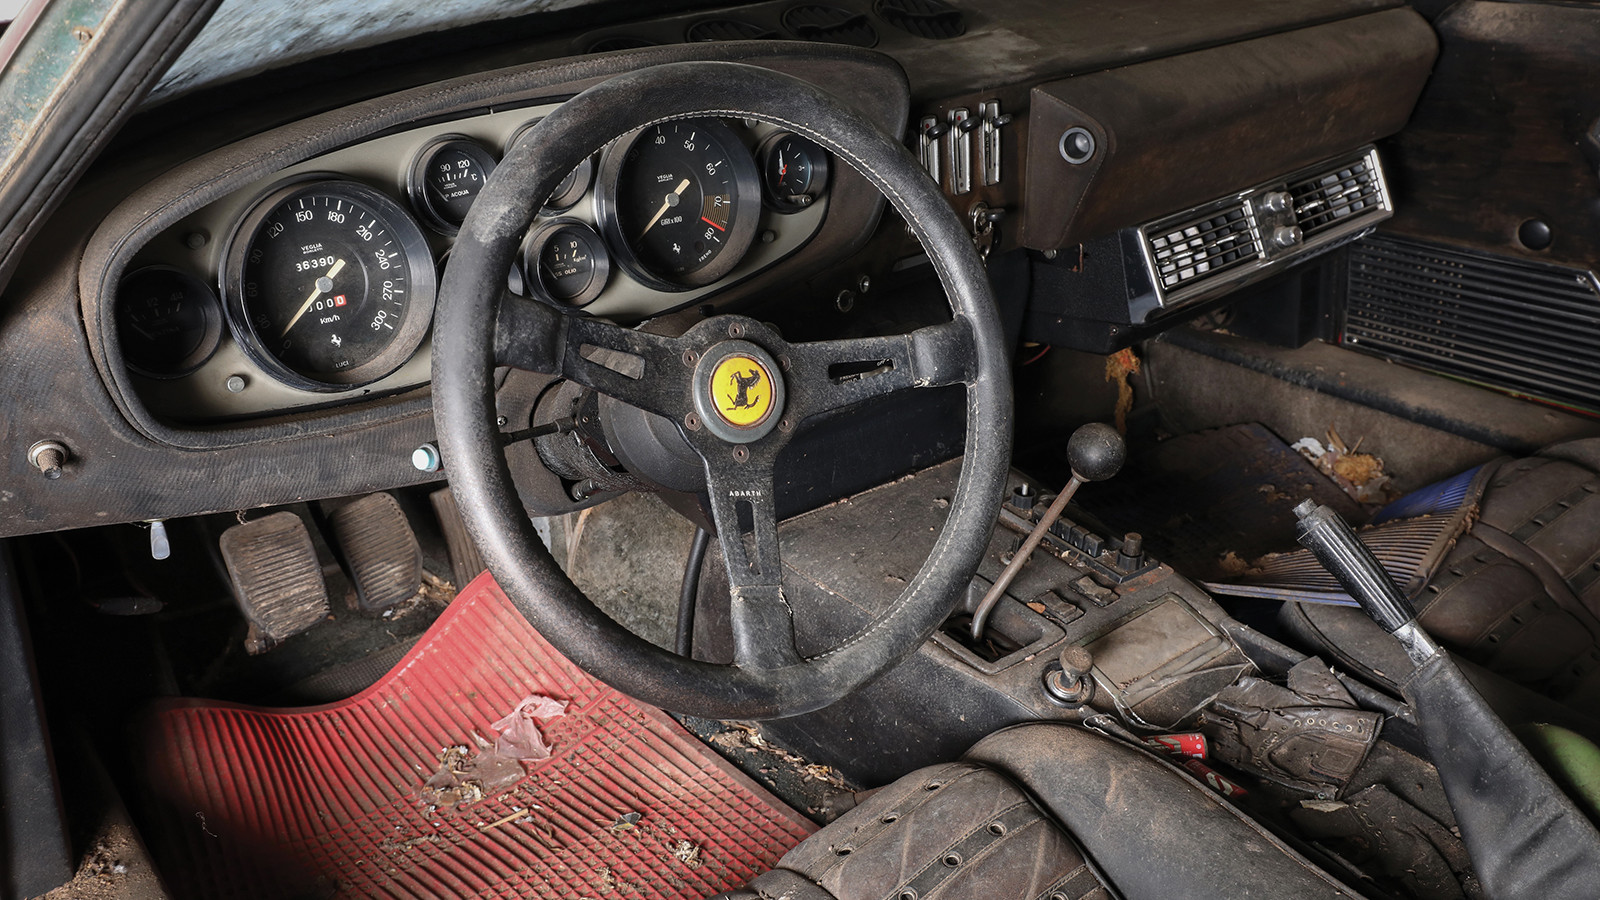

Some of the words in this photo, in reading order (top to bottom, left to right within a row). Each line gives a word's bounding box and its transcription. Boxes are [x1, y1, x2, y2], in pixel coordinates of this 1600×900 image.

[655, 135, 666, 145] 40
[683, 140, 695, 152] 50
[439, 163, 451, 172] 90
[457, 159, 470, 169] 120
[705, 162, 716, 176] 60
[450, 189, 470, 198] ACQUA
[714, 195, 722, 208] 70
[295, 210, 314, 223] 150
[327, 210, 345, 224] 180
[266, 222, 284, 239] 120
[355, 224, 373, 242] 210
[704, 227, 715, 240] 80
[300, 242, 323, 251] VEGLIA
[569, 240, 578, 249] 10
[296, 255, 335, 272] 36390
[374, 249, 390, 270] 240
[382, 280, 393, 300] 270
[319, 314, 341, 325] Km/h
[370, 310, 387, 331] 300
